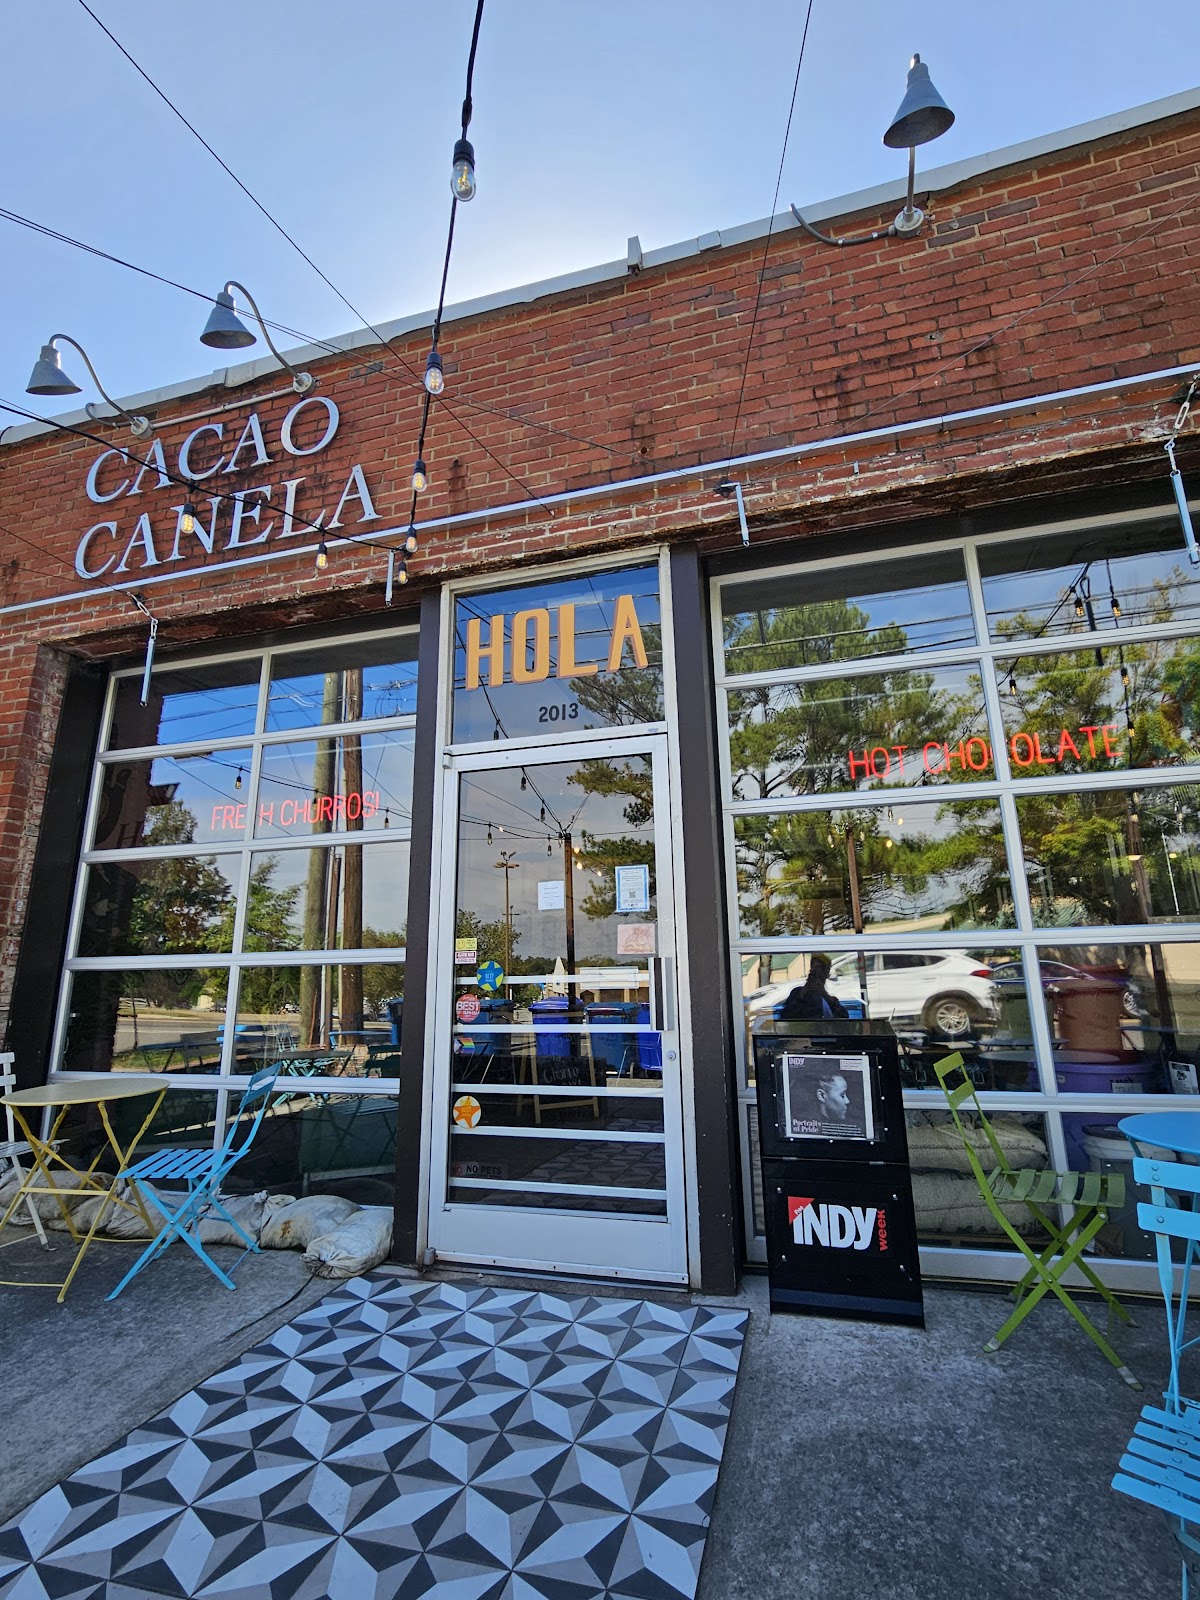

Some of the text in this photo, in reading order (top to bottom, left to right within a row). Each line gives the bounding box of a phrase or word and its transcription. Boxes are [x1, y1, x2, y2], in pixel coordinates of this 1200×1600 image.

[86, 397, 339, 502] CACAO
[75, 464, 382, 579] CANELA
[466, 594, 648, 691] HOLA
[539, 703, 578, 722] 2013
[848, 725, 1124, 779] HOT CHOOLATE
[211, 791, 379, 830] FREH CHURROS!
[456, 1001, 480, 1011] BEST
[788, 1057, 805, 1066] INDY
[793, 1119, 821, 1127] Portraits
[466, 1165, 502, 1175] NO PETS
[792, 1203, 877, 1250] INDY
[877, 1209, 888, 1251] week
